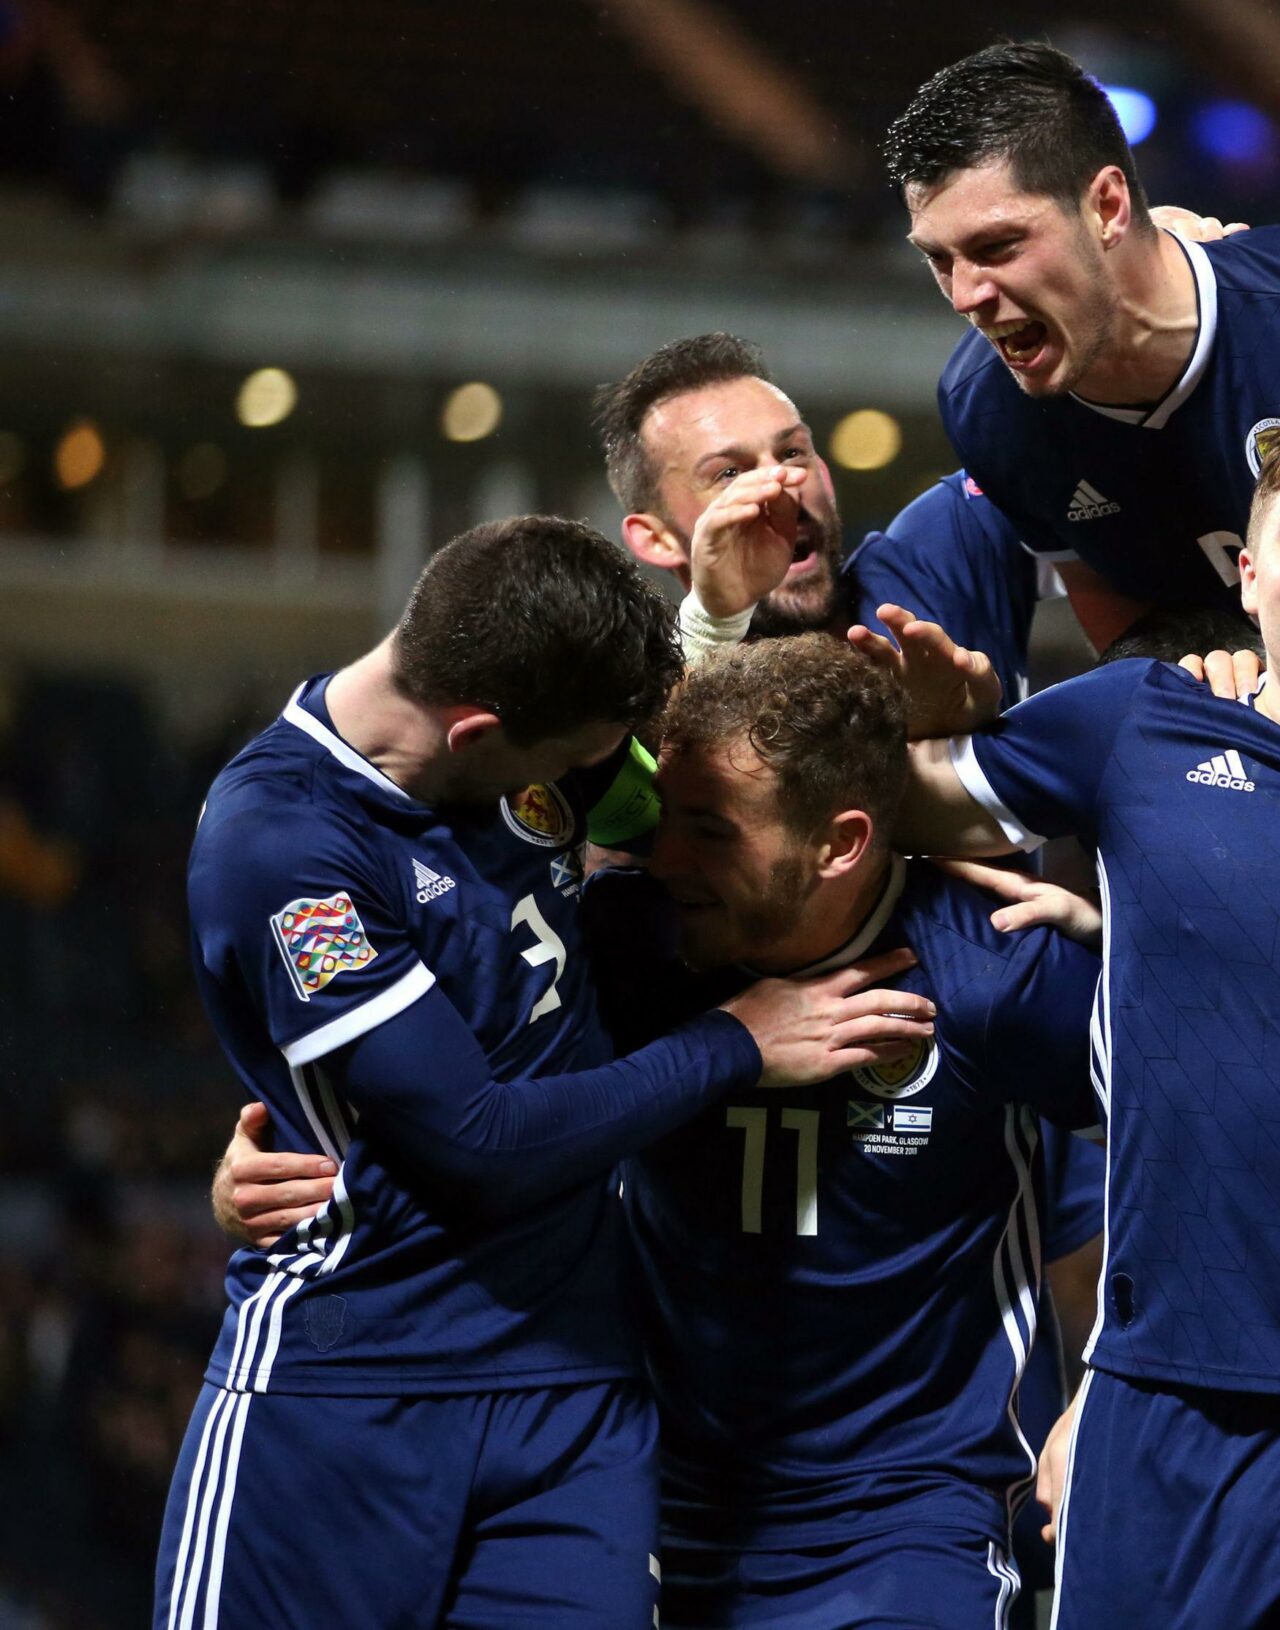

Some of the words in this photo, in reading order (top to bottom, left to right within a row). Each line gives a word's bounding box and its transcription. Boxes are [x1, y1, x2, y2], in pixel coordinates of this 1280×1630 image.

[1067, 502, 1121, 521] adidas
[1186, 768, 1255, 793] adidas
[416, 876, 456, 904] adidas
[511, 893, 567, 1025] 3
[853, 1133, 881, 1143] HAMPDEN
[899, 1137, 929, 1145] GLASGOW
[864, 1144, 871, 1153] 20
[872, 1145, 904, 1154] NOVEMBER
[726, 1106, 820, 1236] 11
